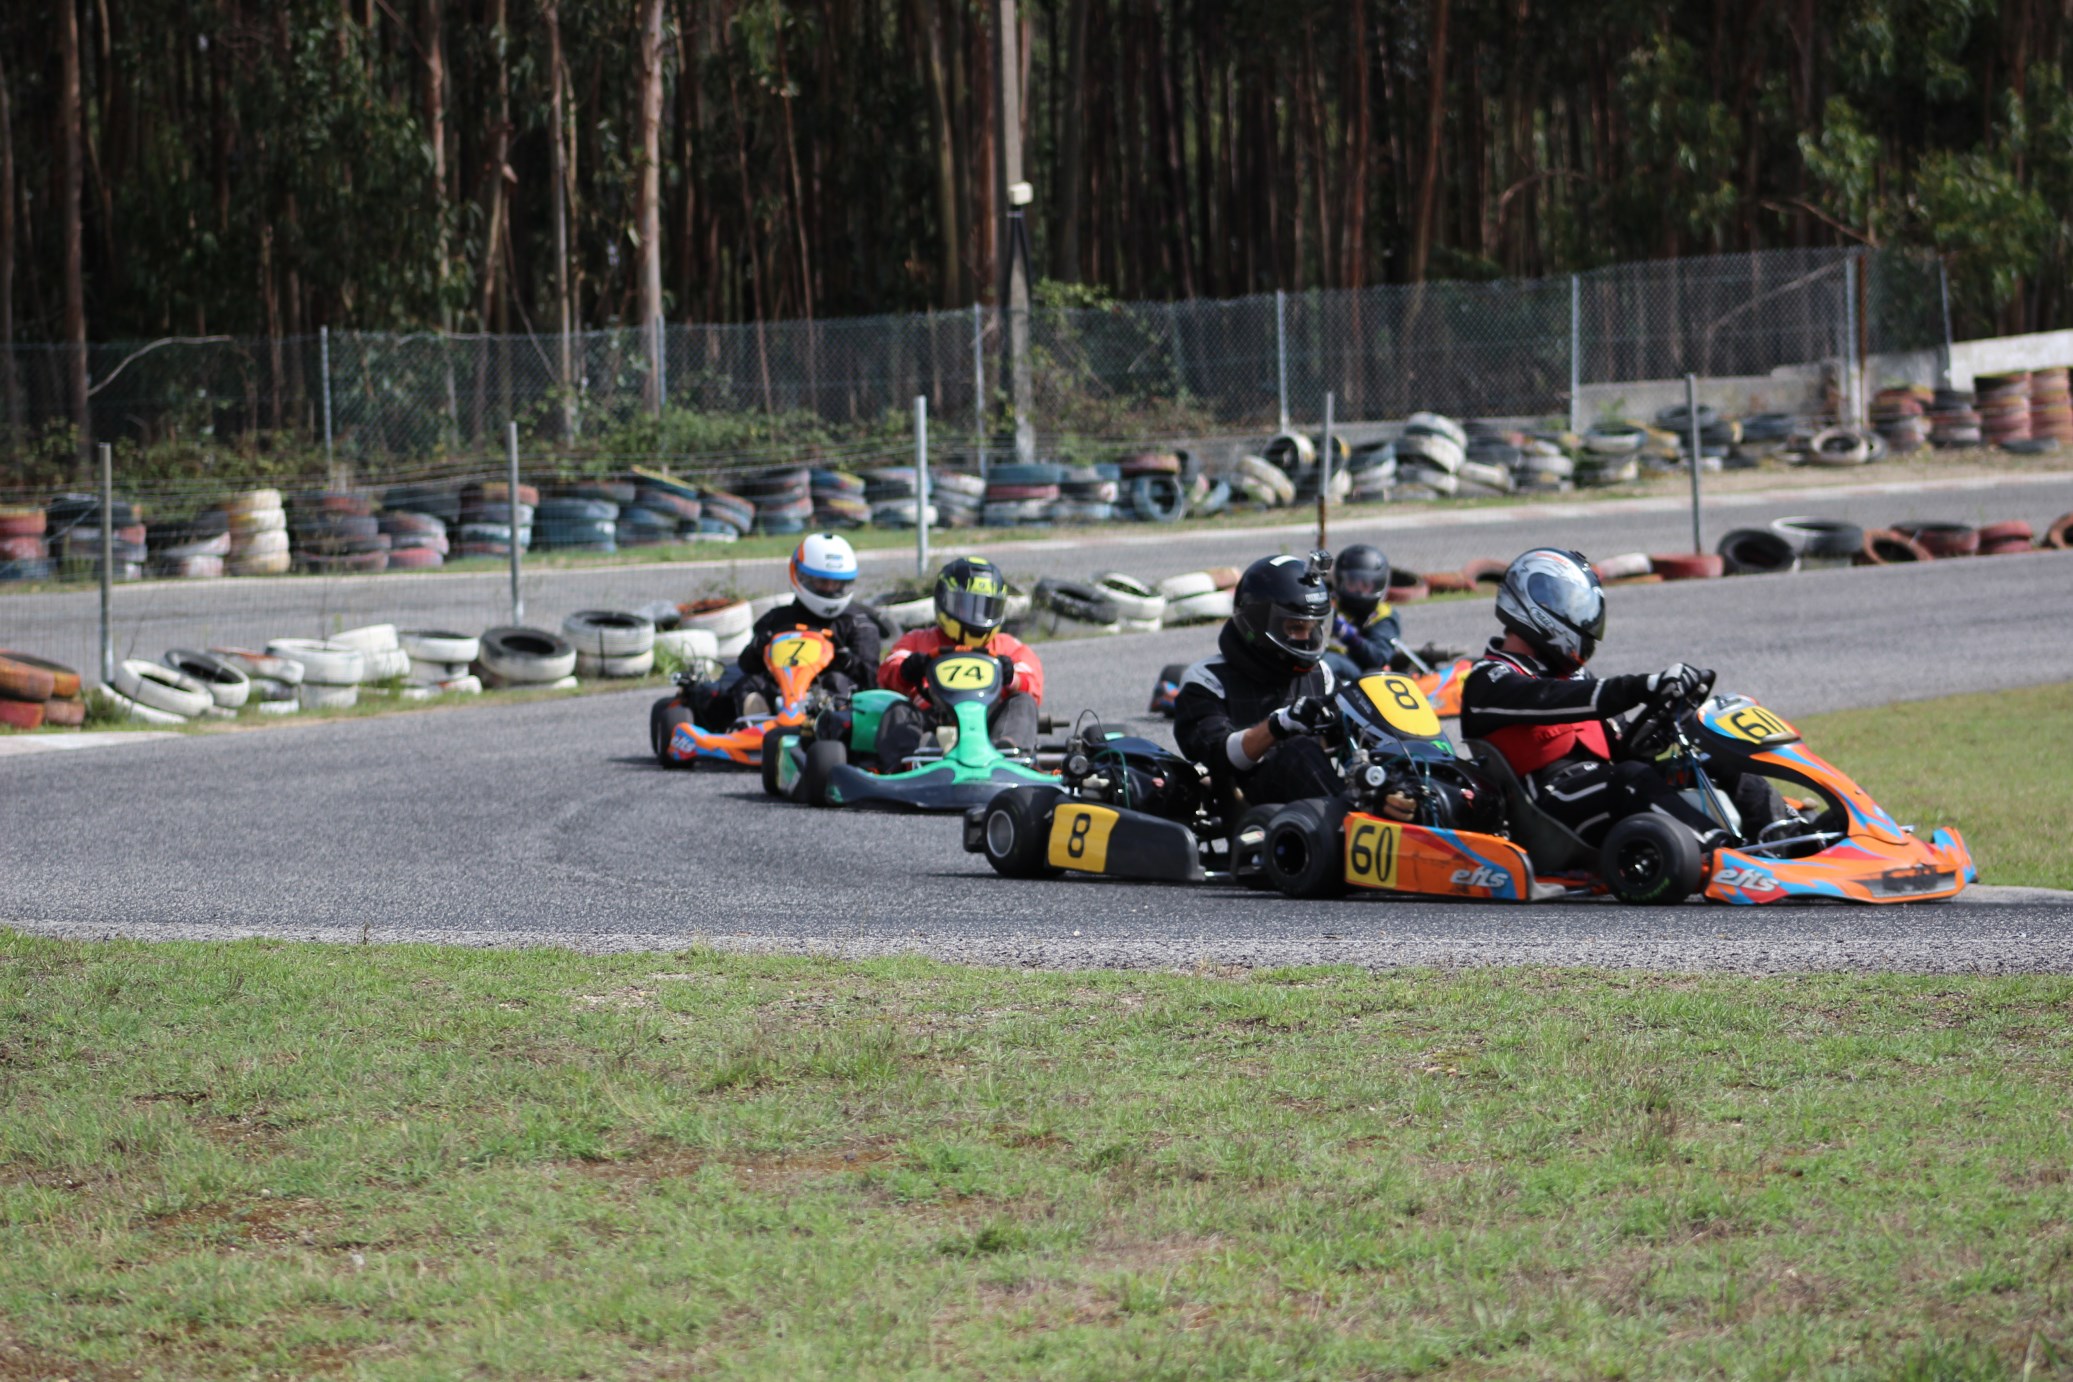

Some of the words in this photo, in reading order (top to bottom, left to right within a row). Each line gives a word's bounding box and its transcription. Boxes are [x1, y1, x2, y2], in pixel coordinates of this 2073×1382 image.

[788, 640, 806, 661] 7
[943, 665, 984, 682] 74
[1385, 679, 1419, 710] 8
[1730, 707, 1787, 740] 60
[1067, 812, 1091, 858] 8
[1352, 824, 1393, 882] 60
